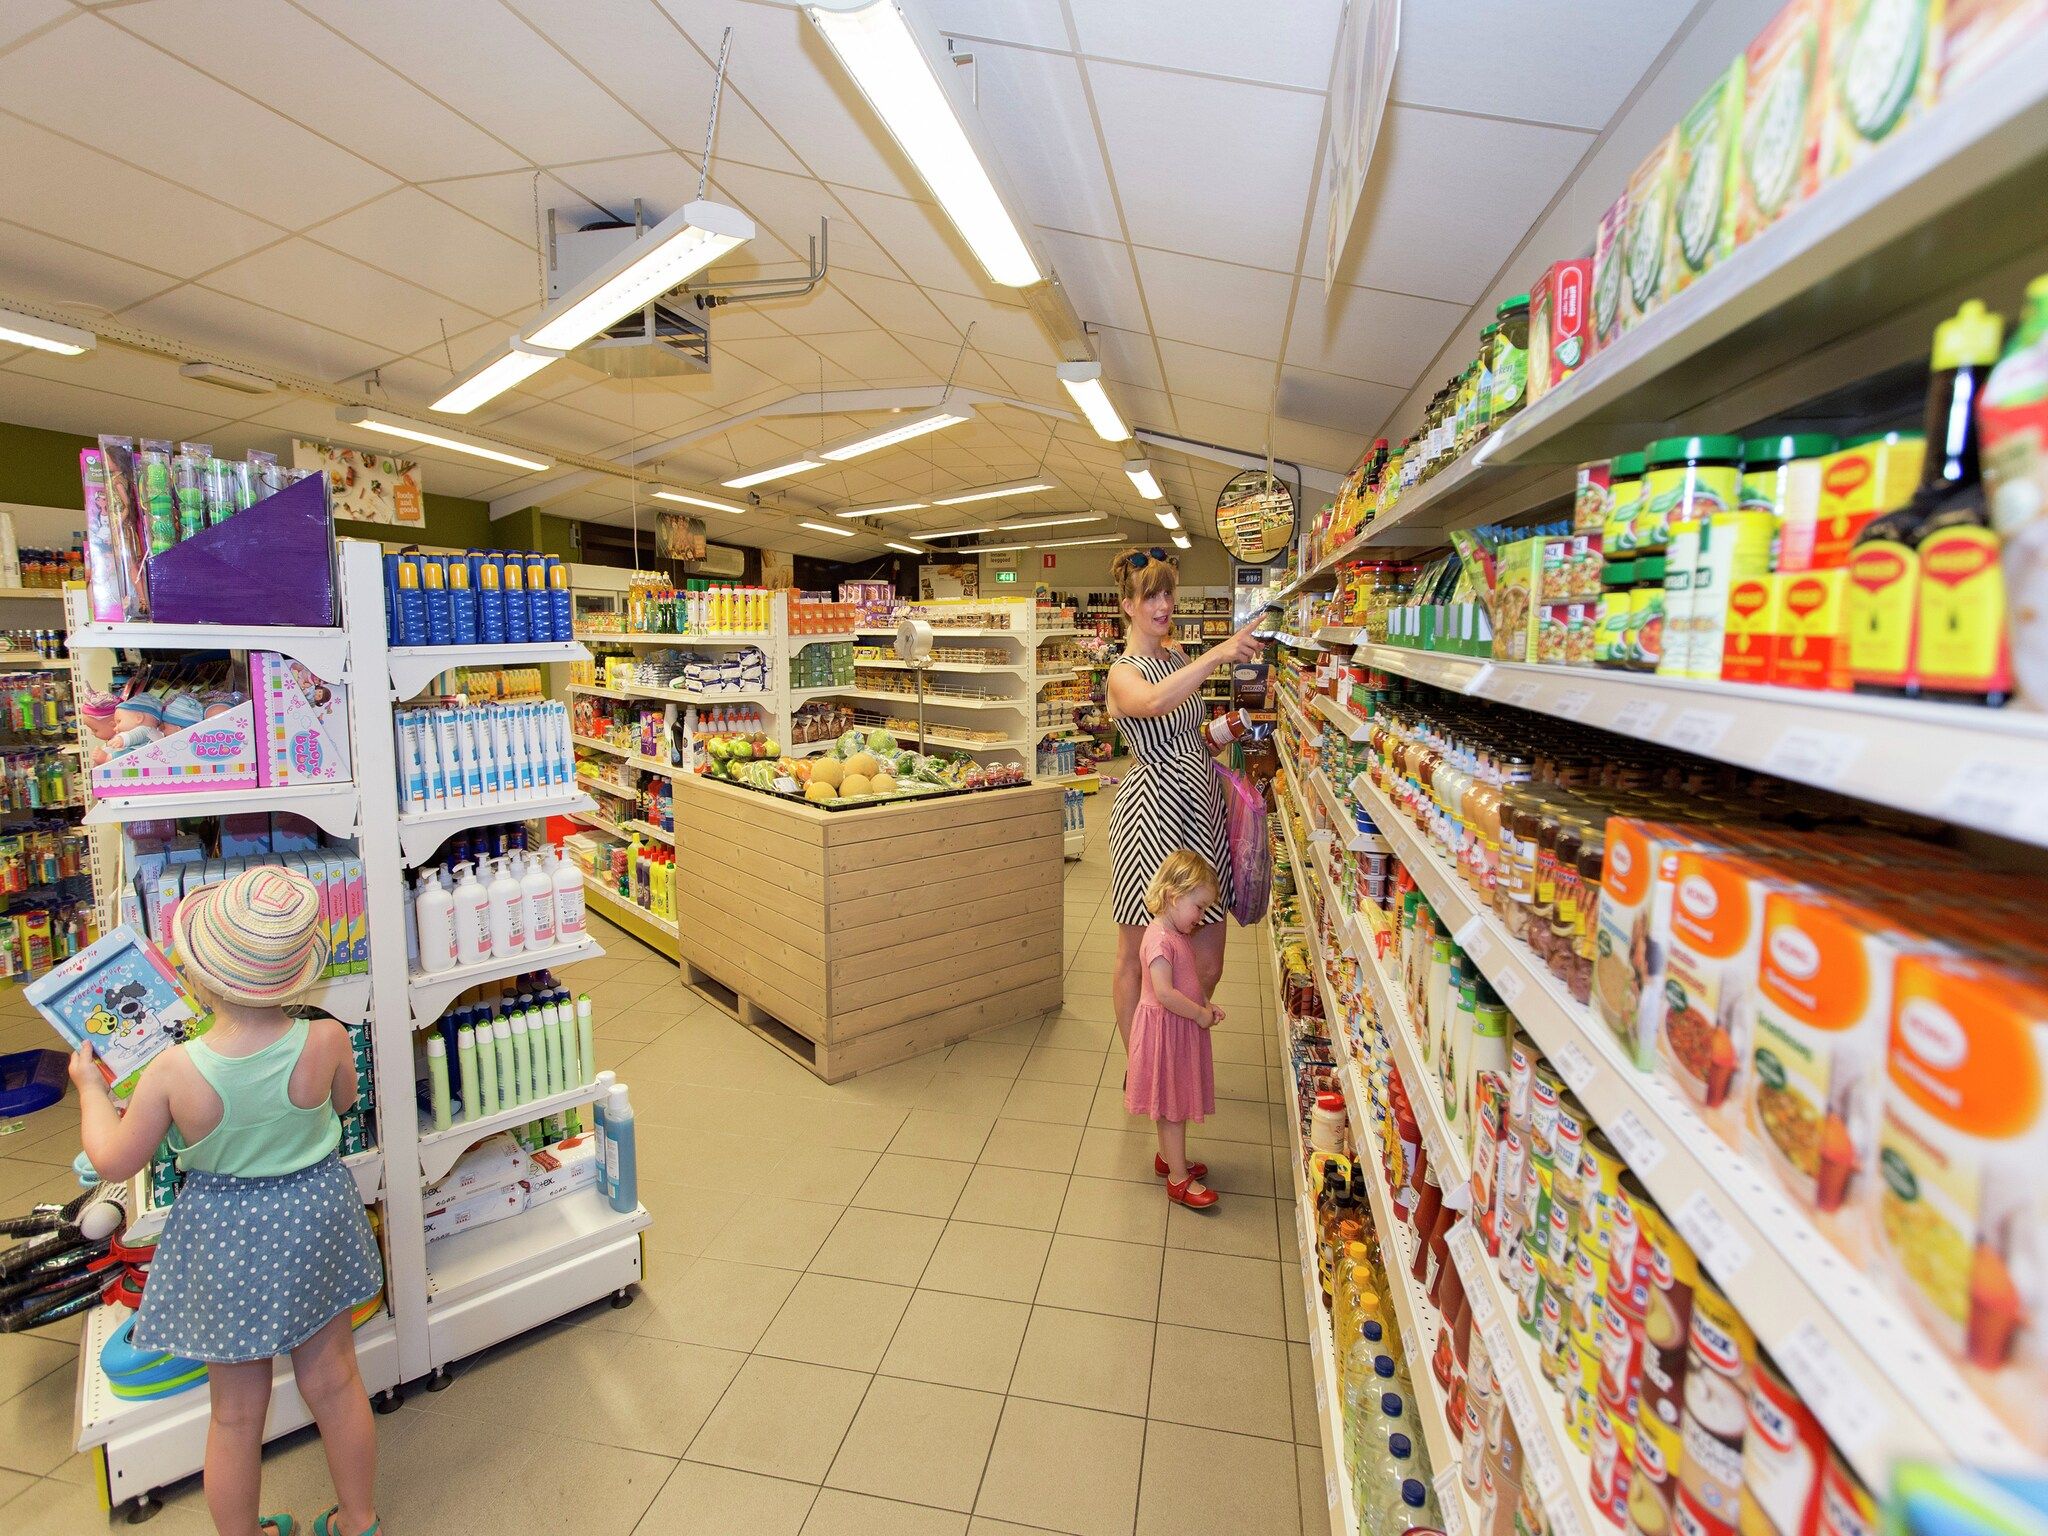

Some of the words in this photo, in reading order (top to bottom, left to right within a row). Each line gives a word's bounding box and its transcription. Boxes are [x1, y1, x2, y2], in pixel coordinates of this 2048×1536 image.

[396, 491, 415, 500] foods
[398, 506, 418, 514] goods
[188, 729, 246, 744] Amore
[195, 744, 242, 757] Bebe
[295, 735, 307, 774] Bebe
[308, 729, 322, 777] Amore
